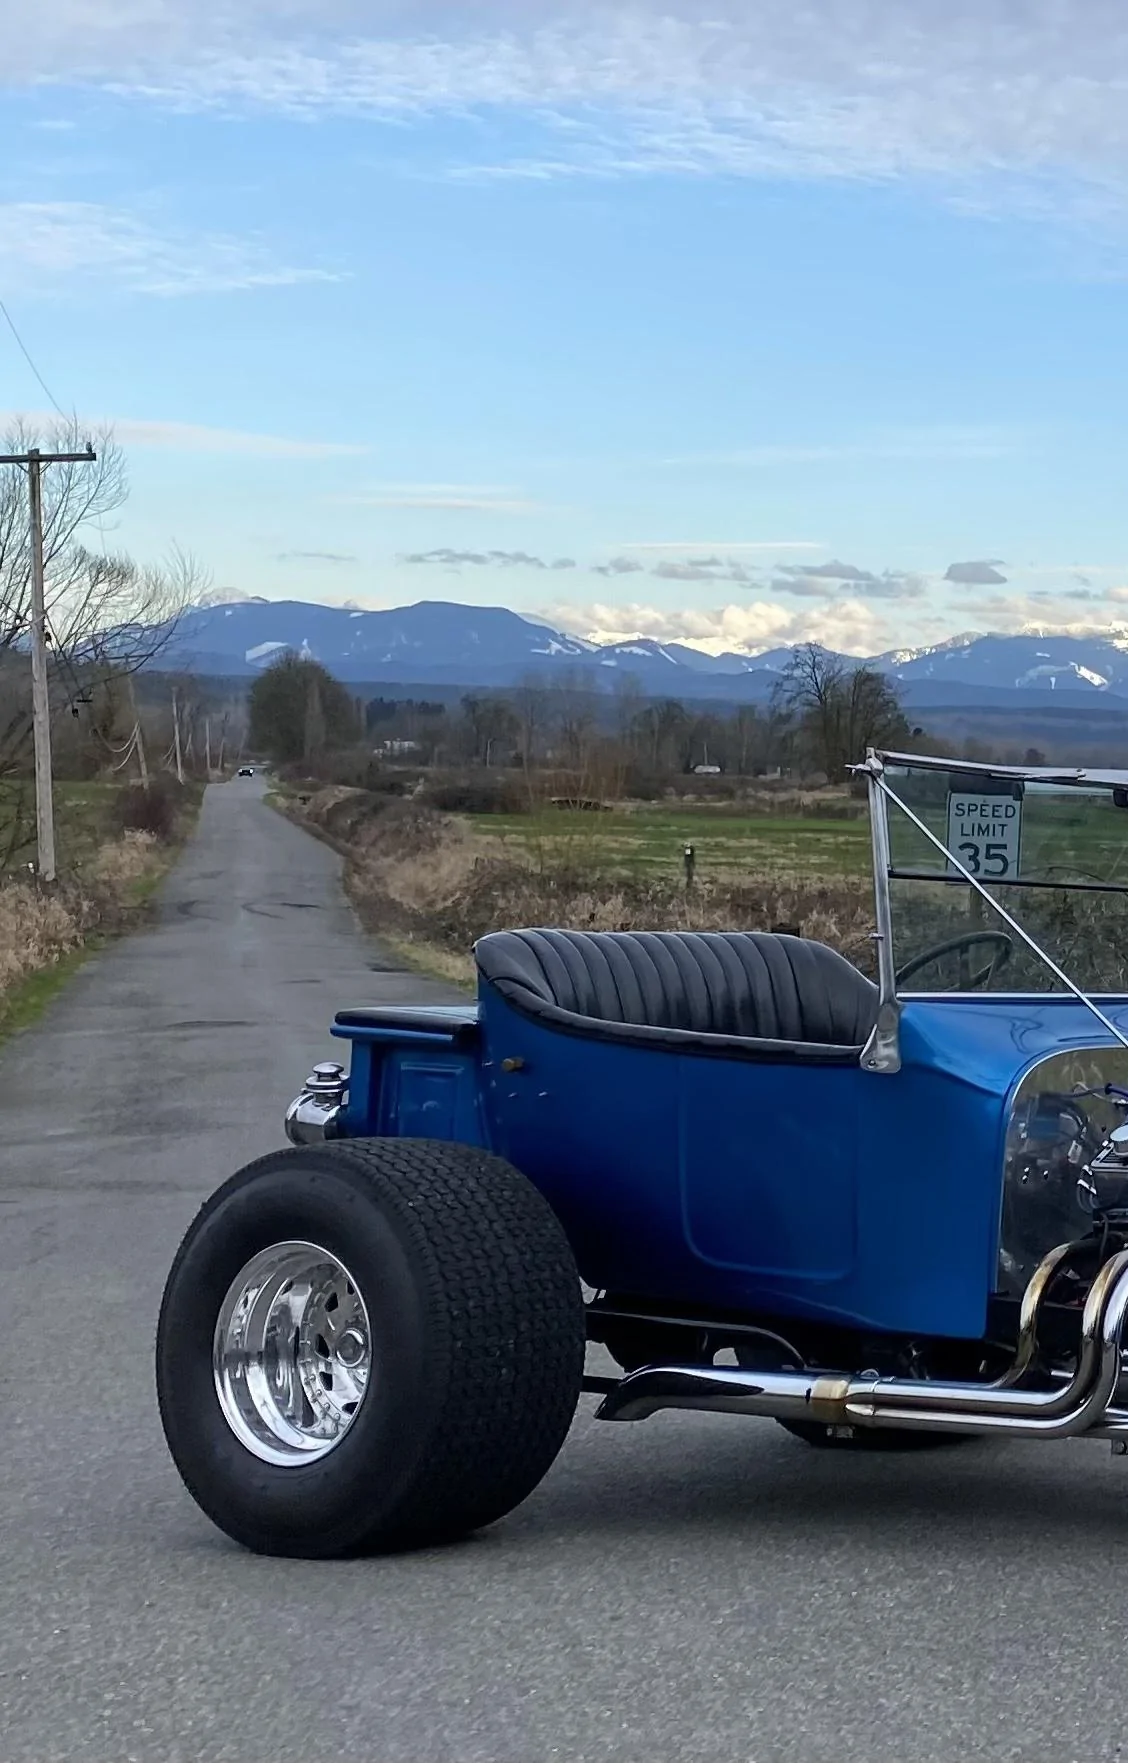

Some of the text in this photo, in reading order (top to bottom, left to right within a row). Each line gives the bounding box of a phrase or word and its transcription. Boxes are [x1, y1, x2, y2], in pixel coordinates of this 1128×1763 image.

[954, 803, 1016, 818] SPEED
[960, 823, 1008, 837] LIMIT
[958, 842, 1009, 877] 35
